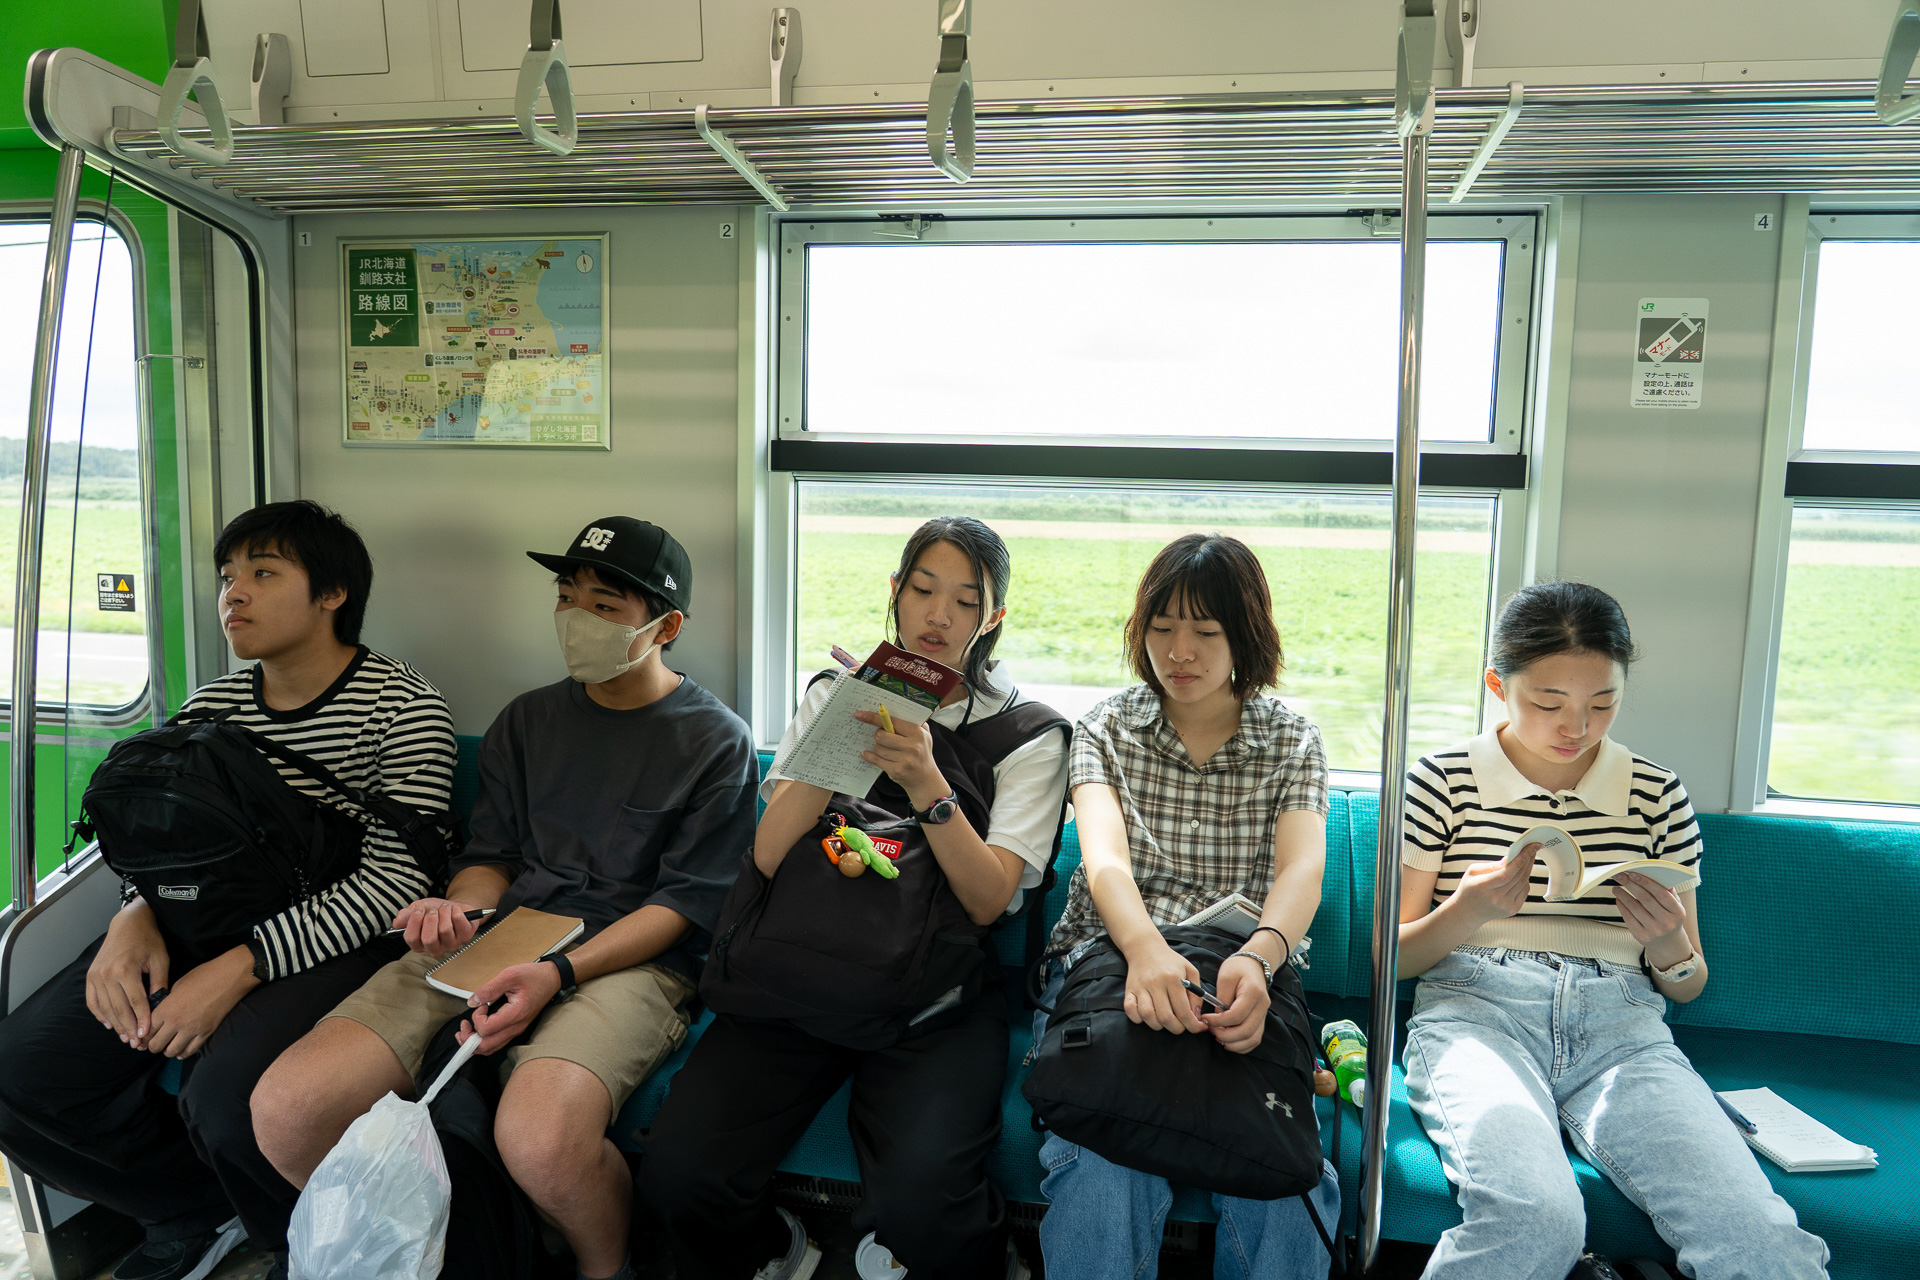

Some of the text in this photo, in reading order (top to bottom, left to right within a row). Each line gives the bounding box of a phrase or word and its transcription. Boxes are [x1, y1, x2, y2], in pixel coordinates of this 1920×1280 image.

[1758, 215, 1768, 229] 4
[723, 224, 731, 237] 2
[301, 233, 307, 245] 1
[359, 257, 406, 269] JR北海道
[360, 272, 407, 285] 釧路支社
[358, 294, 408, 311] 路線図
[1650, 337, 1670, 354] マナー
[1660, 344, 1672, 356] モード
[872, 841, 897, 854] AVIS
[161, 888, 189, 896] Coleman
